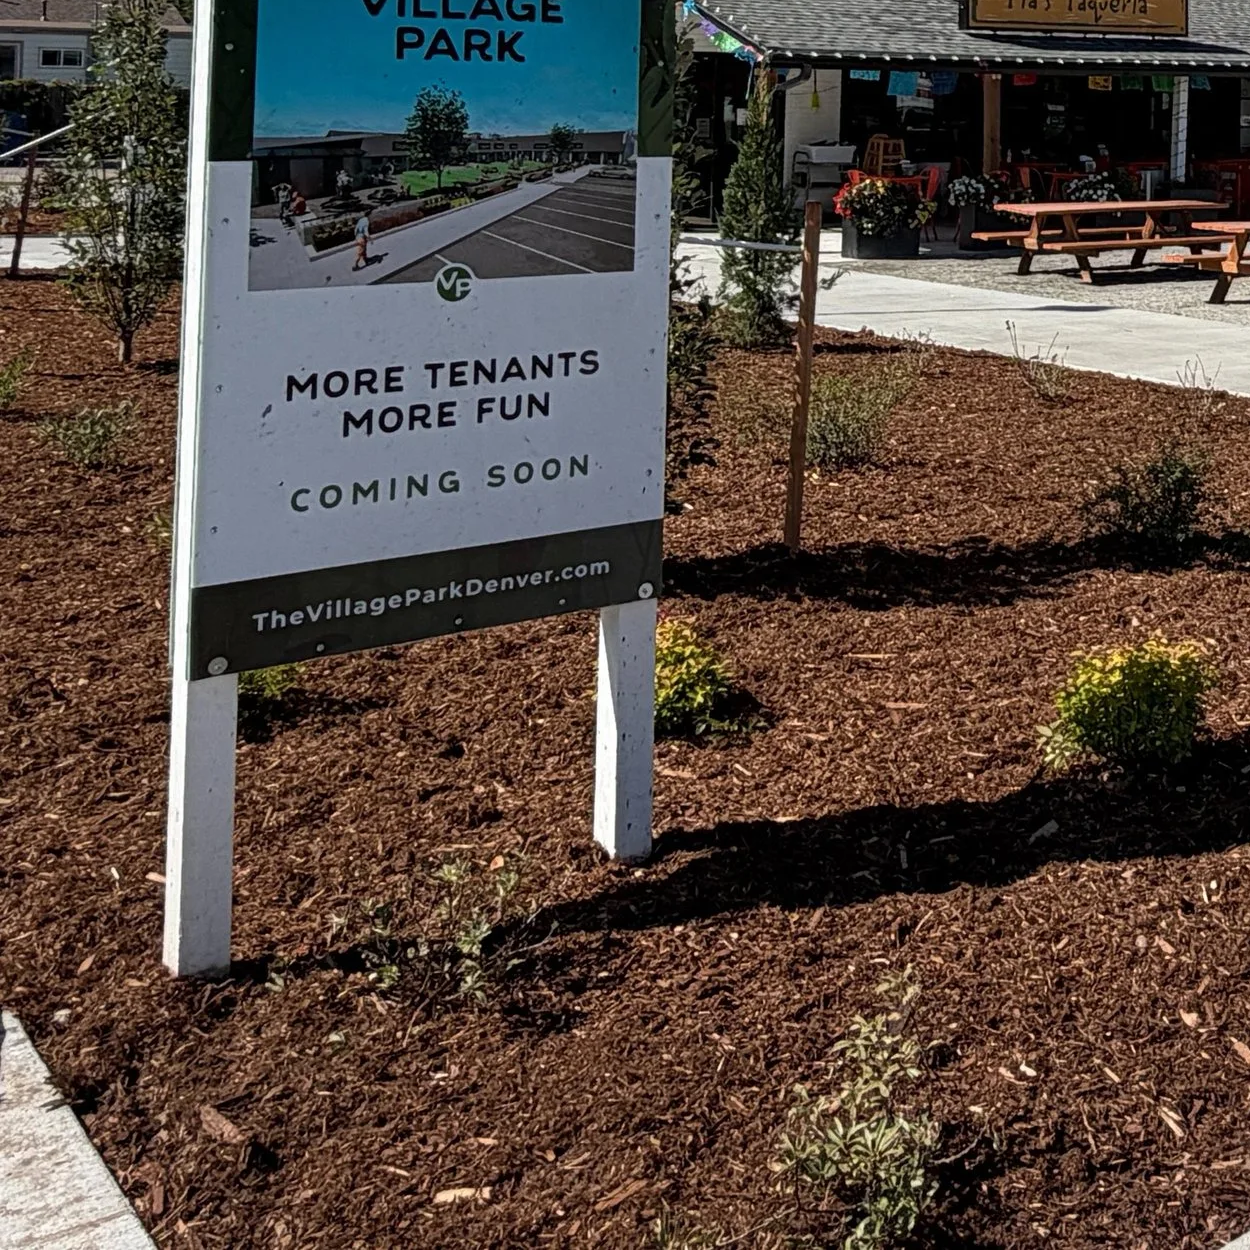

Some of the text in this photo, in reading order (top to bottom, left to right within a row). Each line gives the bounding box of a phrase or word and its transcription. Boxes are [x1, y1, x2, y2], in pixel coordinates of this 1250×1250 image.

[395, 26, 526, 63] PARK
[439, 270, 472, 298] VP
[286, 349, 600, 403] MORE TENANTS
[342, 391, 551, 438] MORE FUN
[290, 453, 591, 513] COMING SOON
[252, 556, 611, 633] TheVillageParkDenver.com
